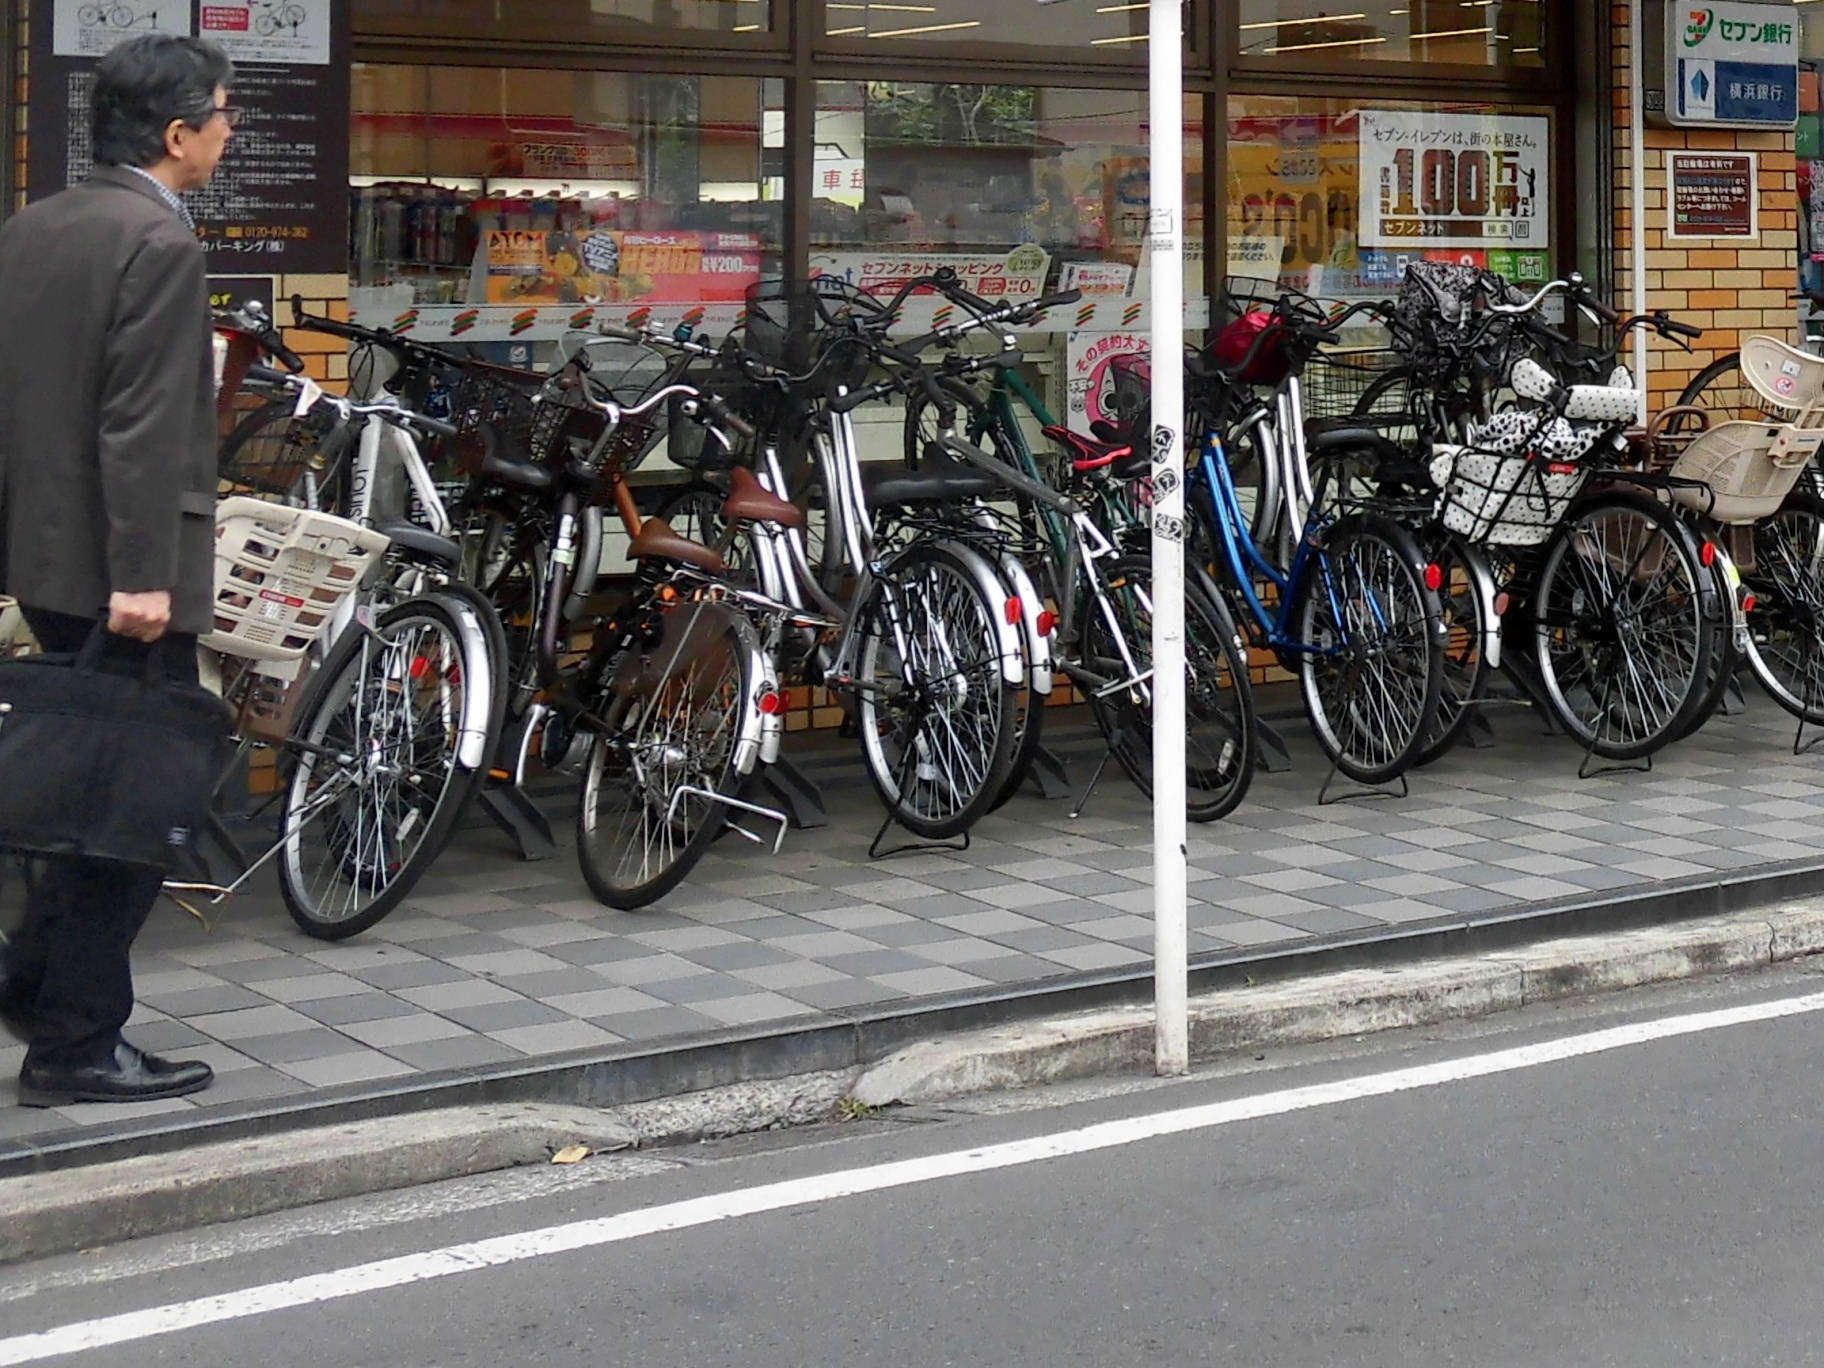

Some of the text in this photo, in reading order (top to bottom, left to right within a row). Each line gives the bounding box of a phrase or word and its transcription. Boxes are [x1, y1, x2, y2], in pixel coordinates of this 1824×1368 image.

[1719, 19, 1792, 44] セブン銀行
[1730, 84, 1783, 102] 横浜銀行
